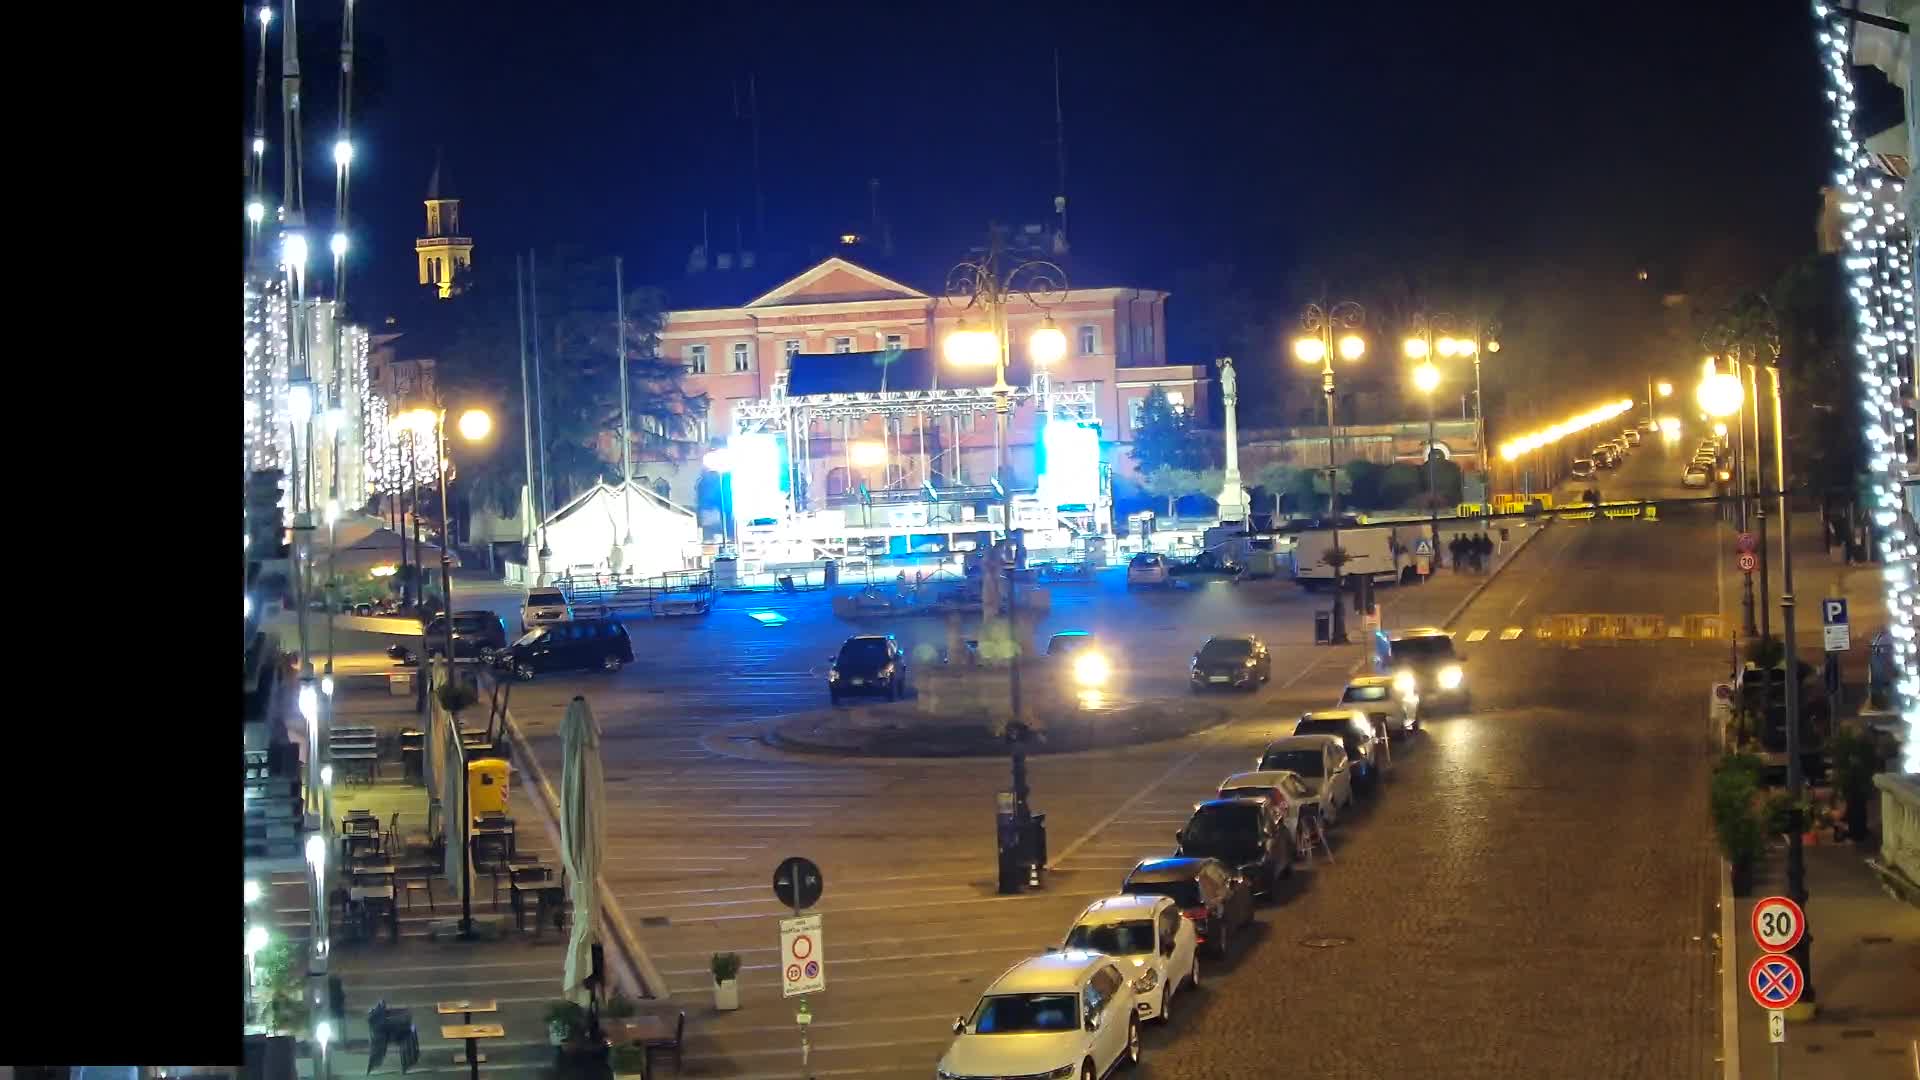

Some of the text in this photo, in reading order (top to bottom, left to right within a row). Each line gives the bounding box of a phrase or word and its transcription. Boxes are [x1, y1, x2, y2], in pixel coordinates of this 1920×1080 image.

[1742, 557, 1753, 567] 20
[1827, 602, 1842, 622] P
[1762, 911, 1792, 937] 30
